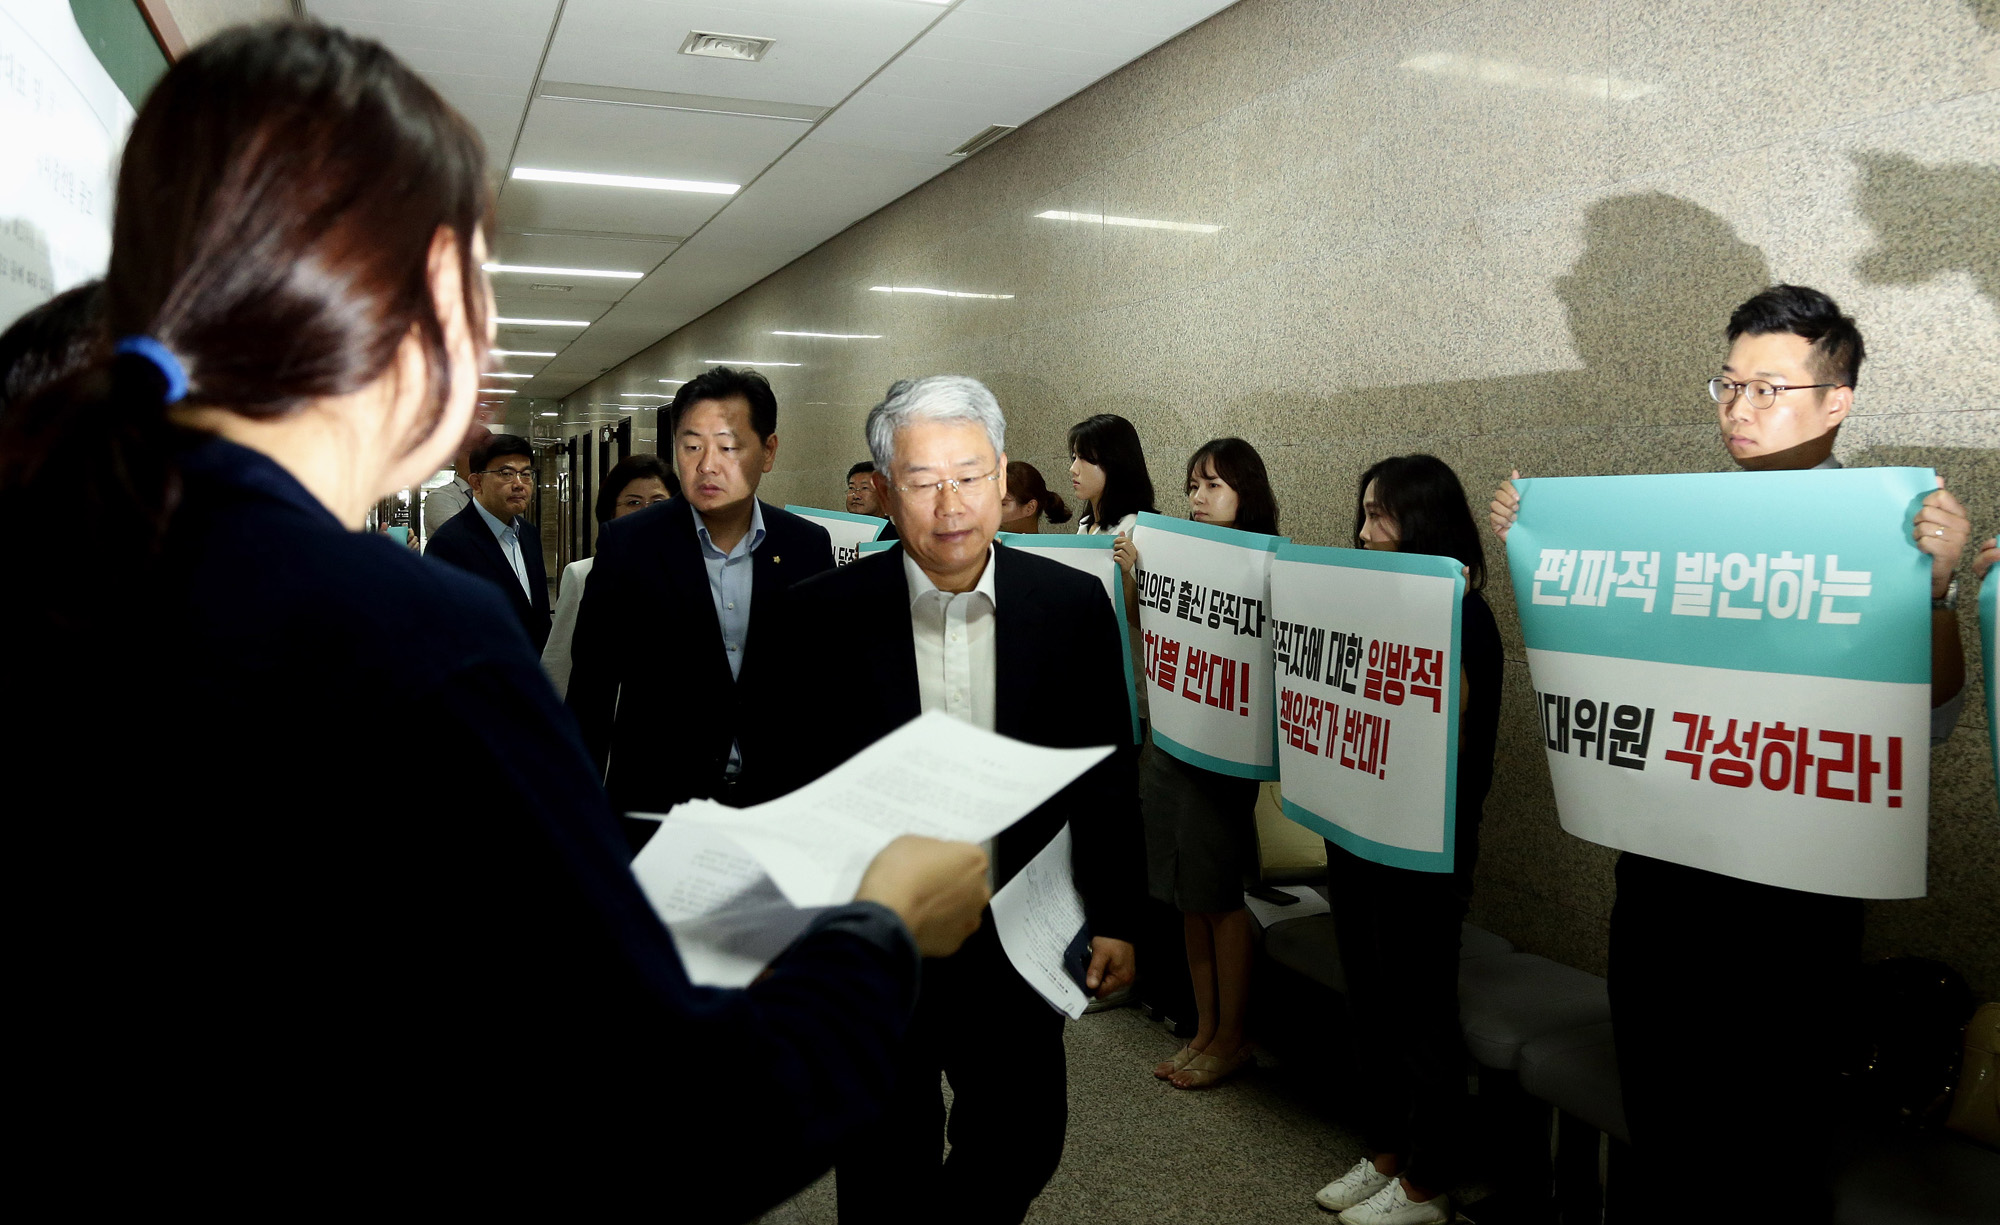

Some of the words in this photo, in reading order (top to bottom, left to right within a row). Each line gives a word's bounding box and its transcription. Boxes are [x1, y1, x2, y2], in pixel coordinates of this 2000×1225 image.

[1135, 568, 1175, 614] 민의당
[1176, 580, 1207, 625] 출신
[1207, 589, 1266, 639] 당직자
[1532, 548, 1660, 614] 편파적
[1671, 551, 1872, 625] 발언하는
[1141, 628, 1181, 692] 차별
[1182, 646, 1250, 717] 반대!
[1325, 631, 1364, 695] 대한
[1364, 639, 1443, 713] 일방적
[1280, 686, 1339, 759] 책임전가
[1340, 708, 1391, 780] 반대!
[1665, 711, 1903, 809] 각성하라!
